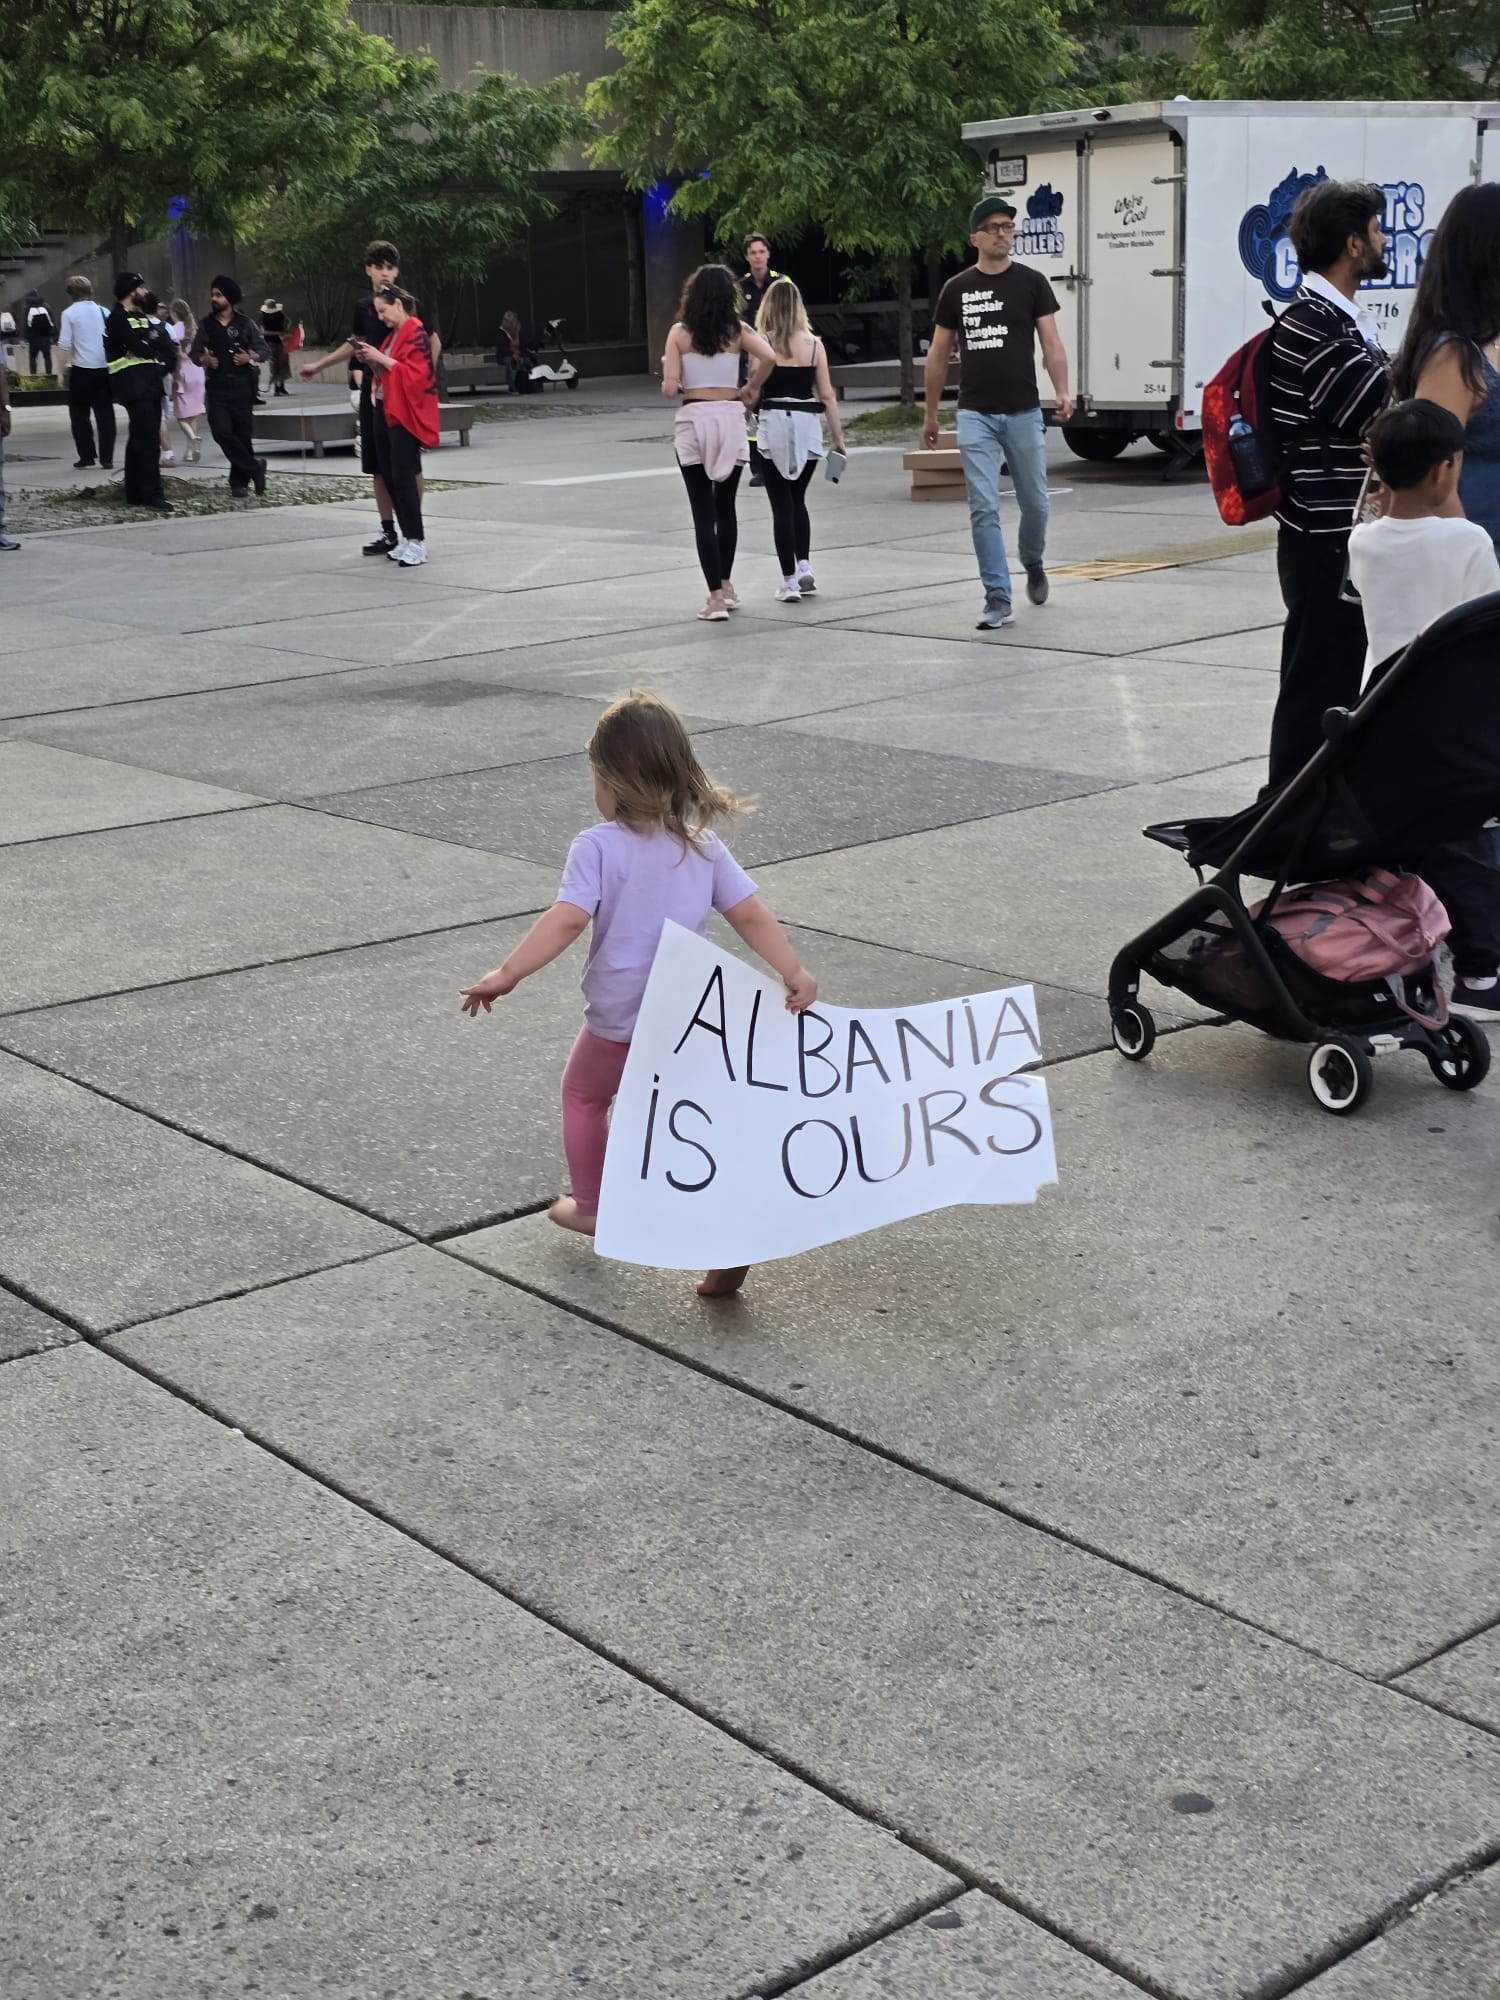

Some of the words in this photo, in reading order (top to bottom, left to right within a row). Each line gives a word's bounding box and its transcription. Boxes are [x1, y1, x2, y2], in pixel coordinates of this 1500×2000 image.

[1123, 206, 1148, 226] Cool
[962, 290, 994, 304] Baker
[962, 299, 1004, 315] Sinclair
[962, 316, 981, 328] Fay
[965, 324, 1009, 339] Langlois
[966, 337, 1004, 351] Downie
[781, 1075, 1043, 1200] OURS
